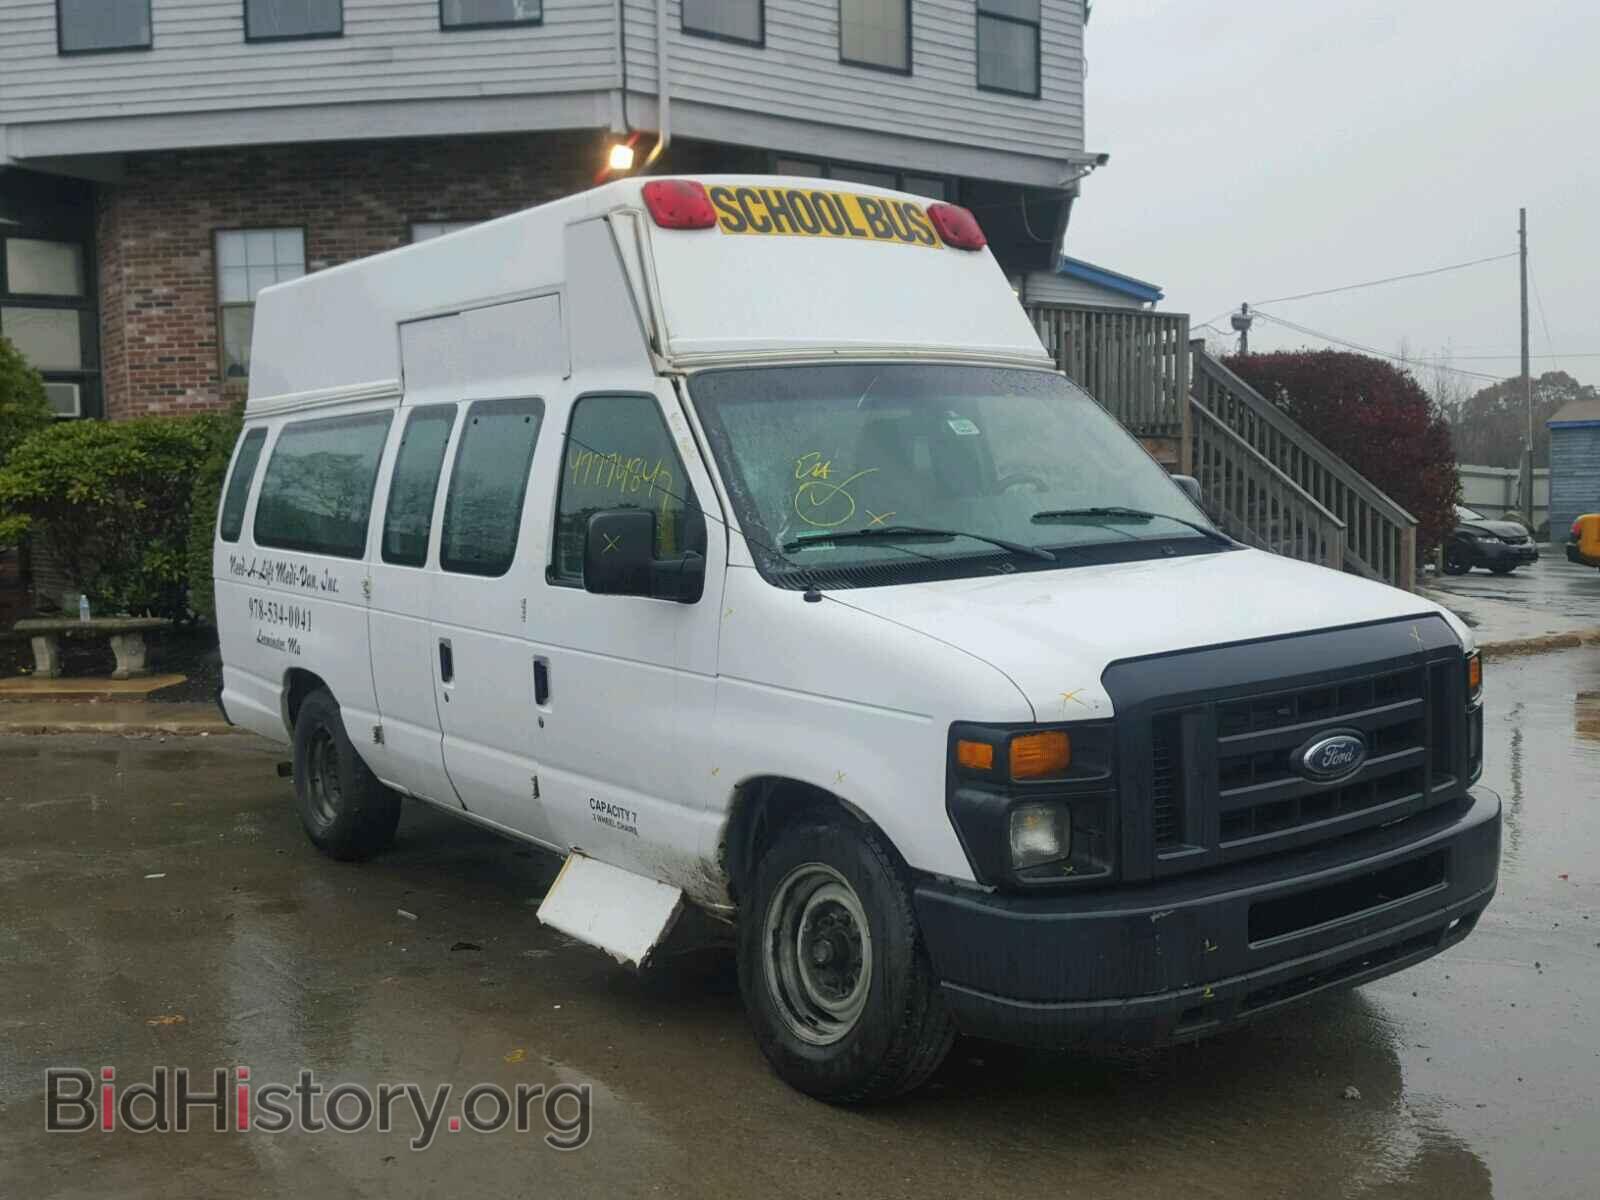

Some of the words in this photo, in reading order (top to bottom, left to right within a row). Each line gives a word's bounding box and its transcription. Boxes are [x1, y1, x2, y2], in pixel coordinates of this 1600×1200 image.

[710, 186, 867, 237] SCHOOL
[861, 196, 936, 246] BUS
[320, 567, 340, 593] Inc.
[248, 597, 312, 632] 978-534-0041
[1322, 742, 1354, 767] Ford
[589, 797, 630, 821] CAPACITY
[631, 811, 638, 824] 7
